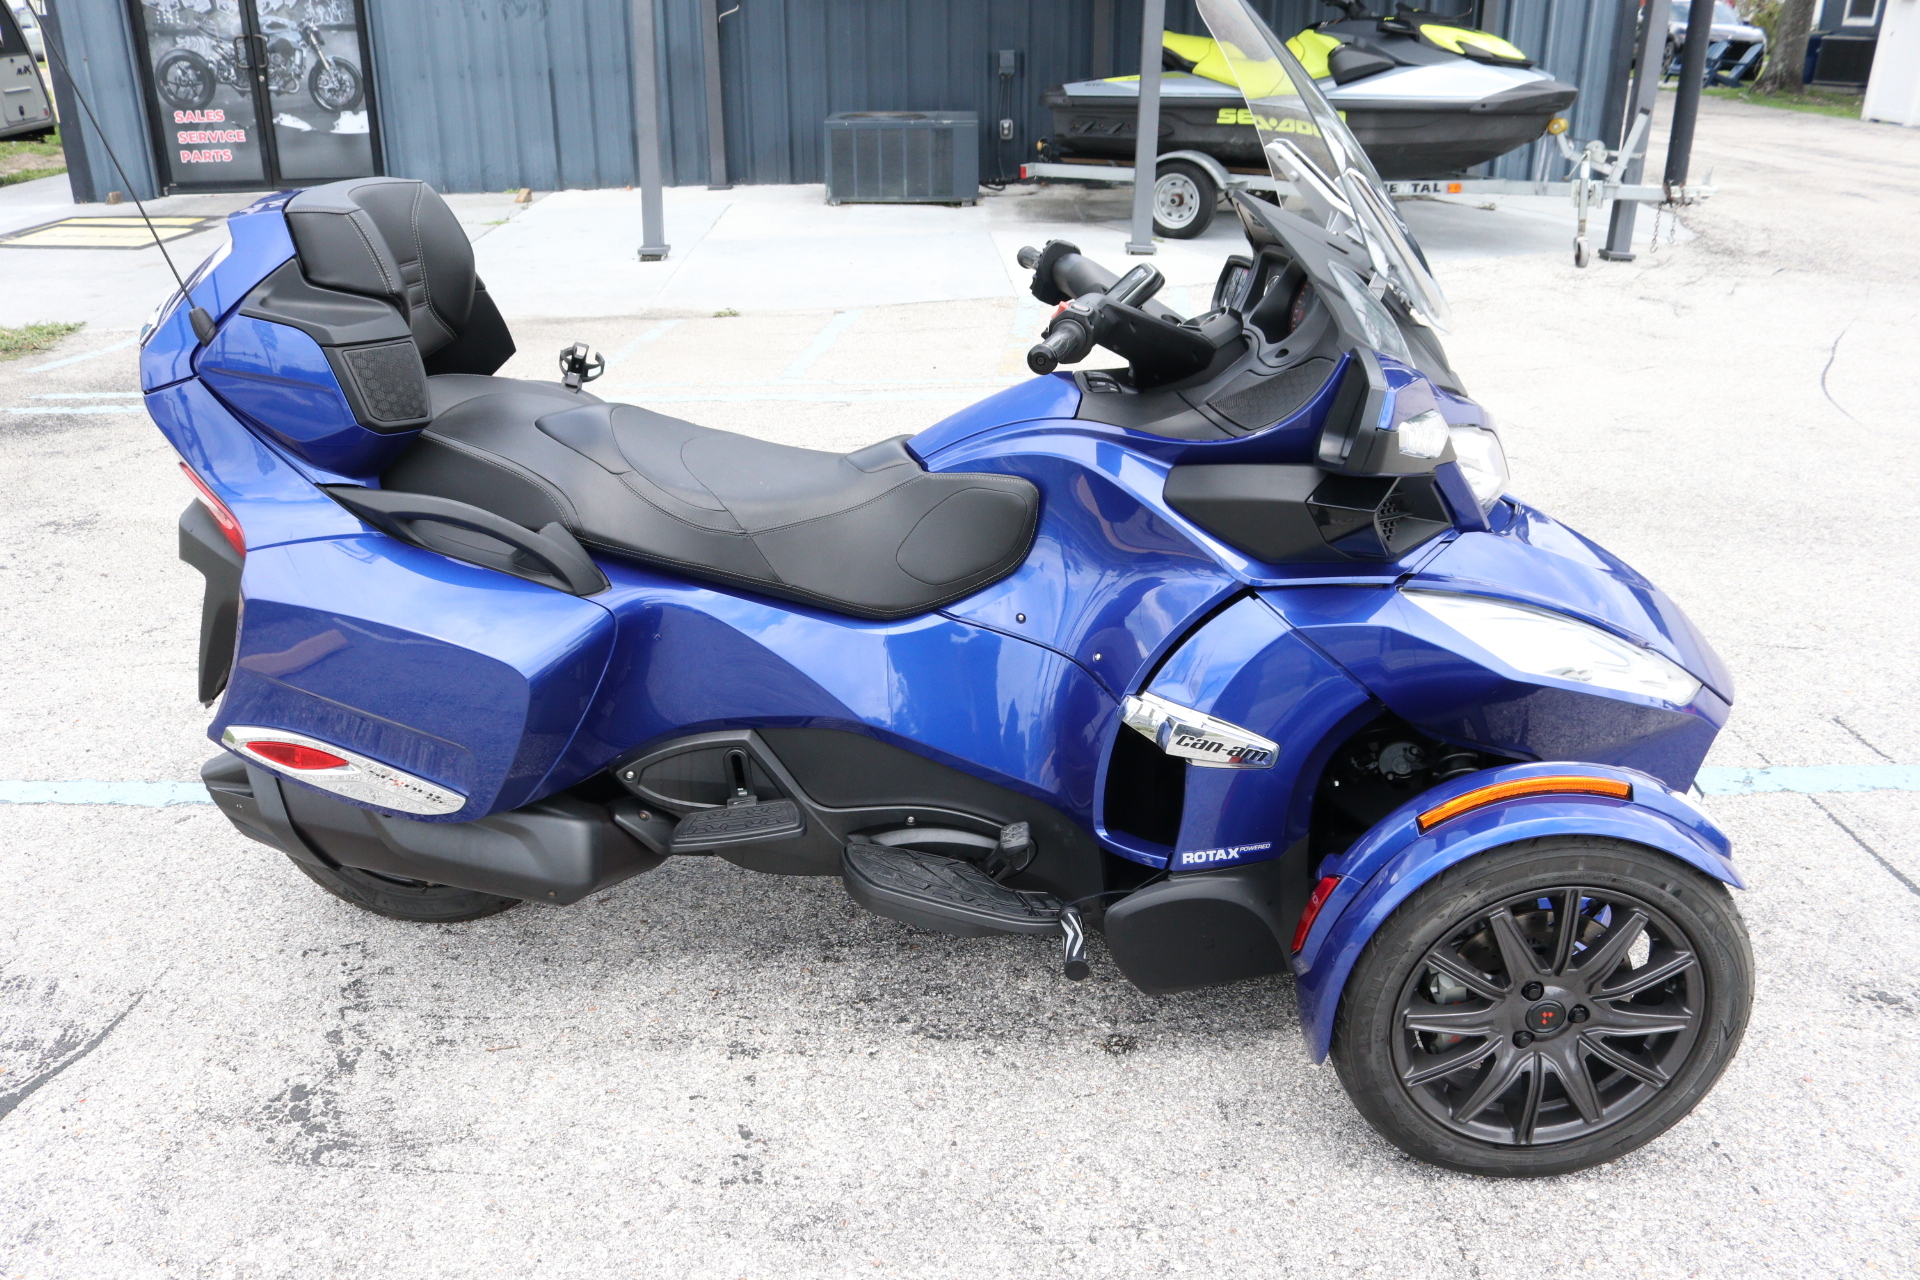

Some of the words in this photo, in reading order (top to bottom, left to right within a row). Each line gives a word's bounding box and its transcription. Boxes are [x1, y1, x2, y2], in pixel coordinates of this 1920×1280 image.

[174, 109, 225, 123] SALES
[177, 129, 246, 144] SERVICE
[180, 149, 232, 163] PARTS
[1182, 848, 1239, 864] ROTAX
[1239, 842, 1271, 852] POWERED
